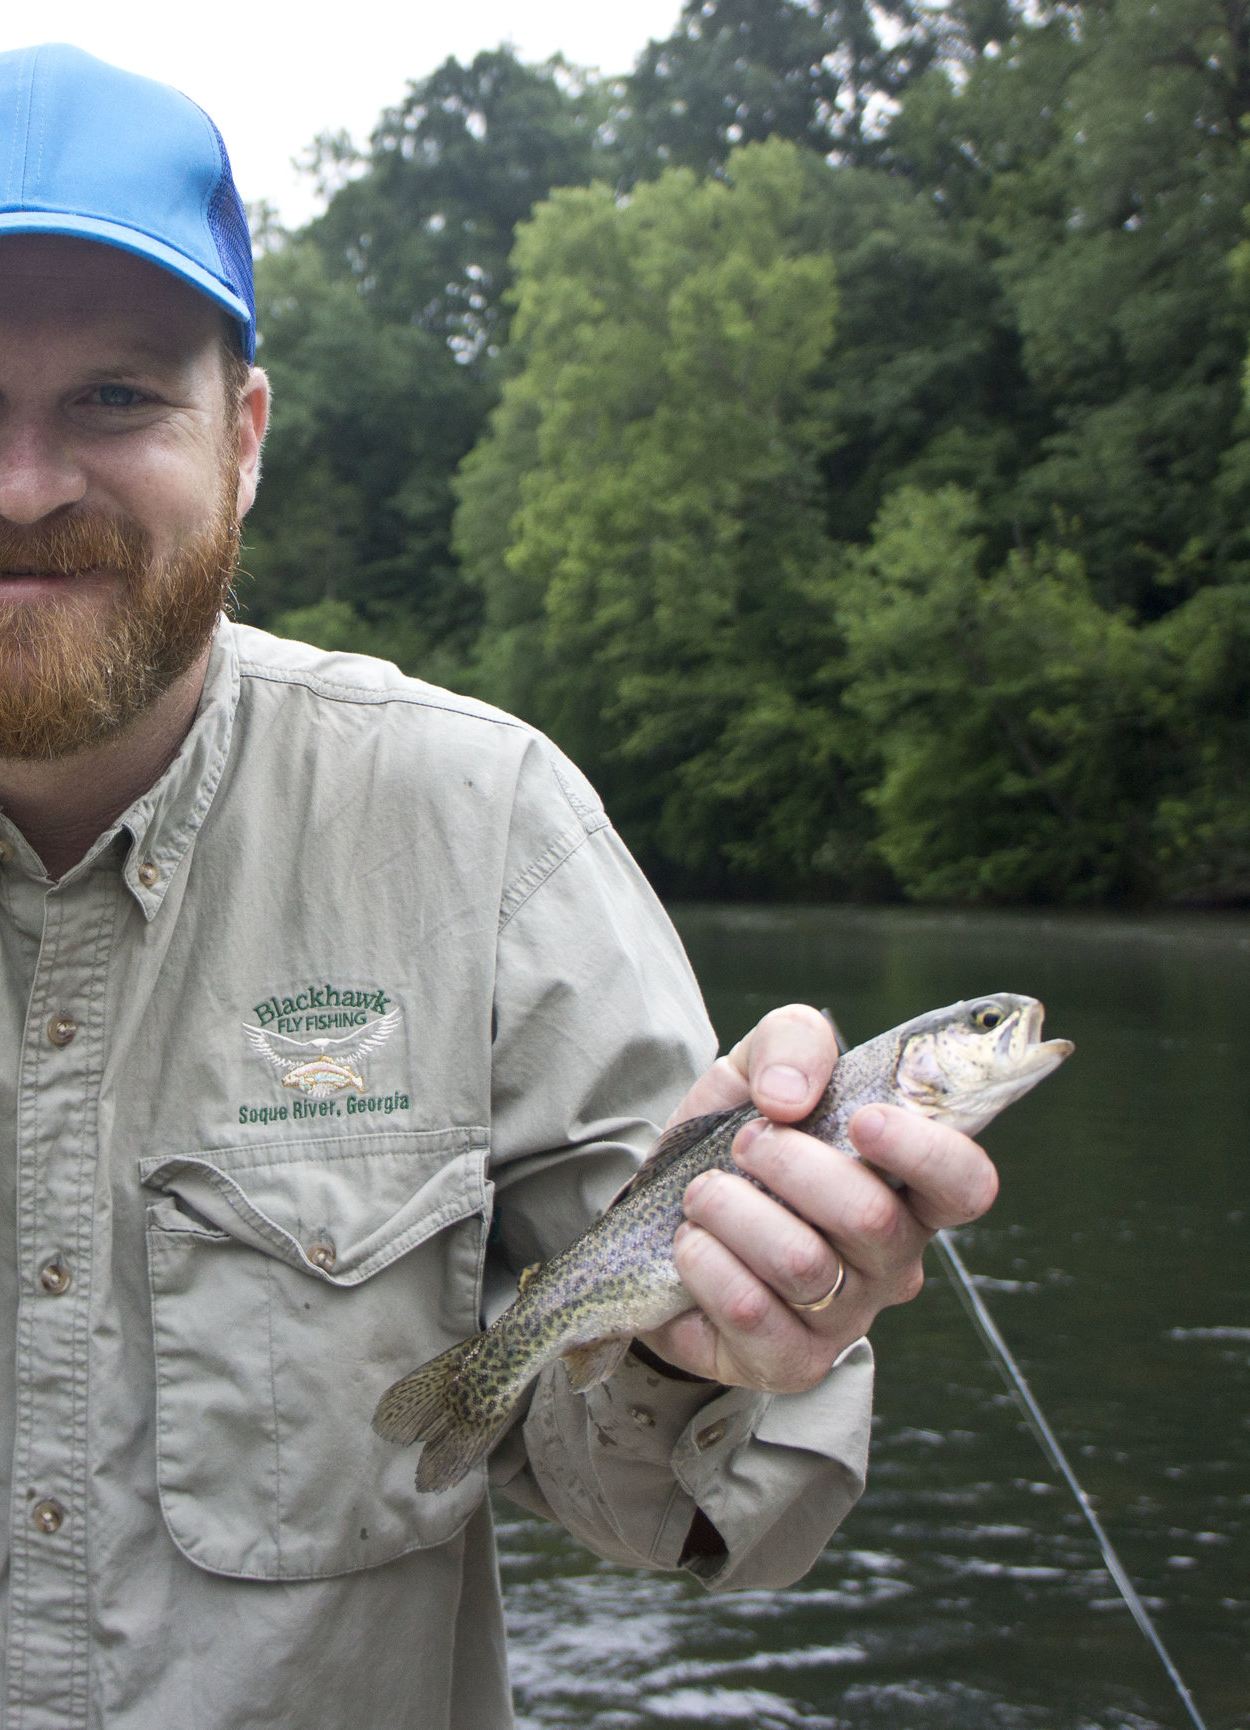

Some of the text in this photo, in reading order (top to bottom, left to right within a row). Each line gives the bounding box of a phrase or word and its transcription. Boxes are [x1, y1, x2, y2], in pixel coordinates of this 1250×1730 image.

[252, 984, 391, 1027] Blackhawk
[278, 1011, 367, 1034] FLY FISHING
[239, 1092, 410, 1125] Soque River, Georgia
